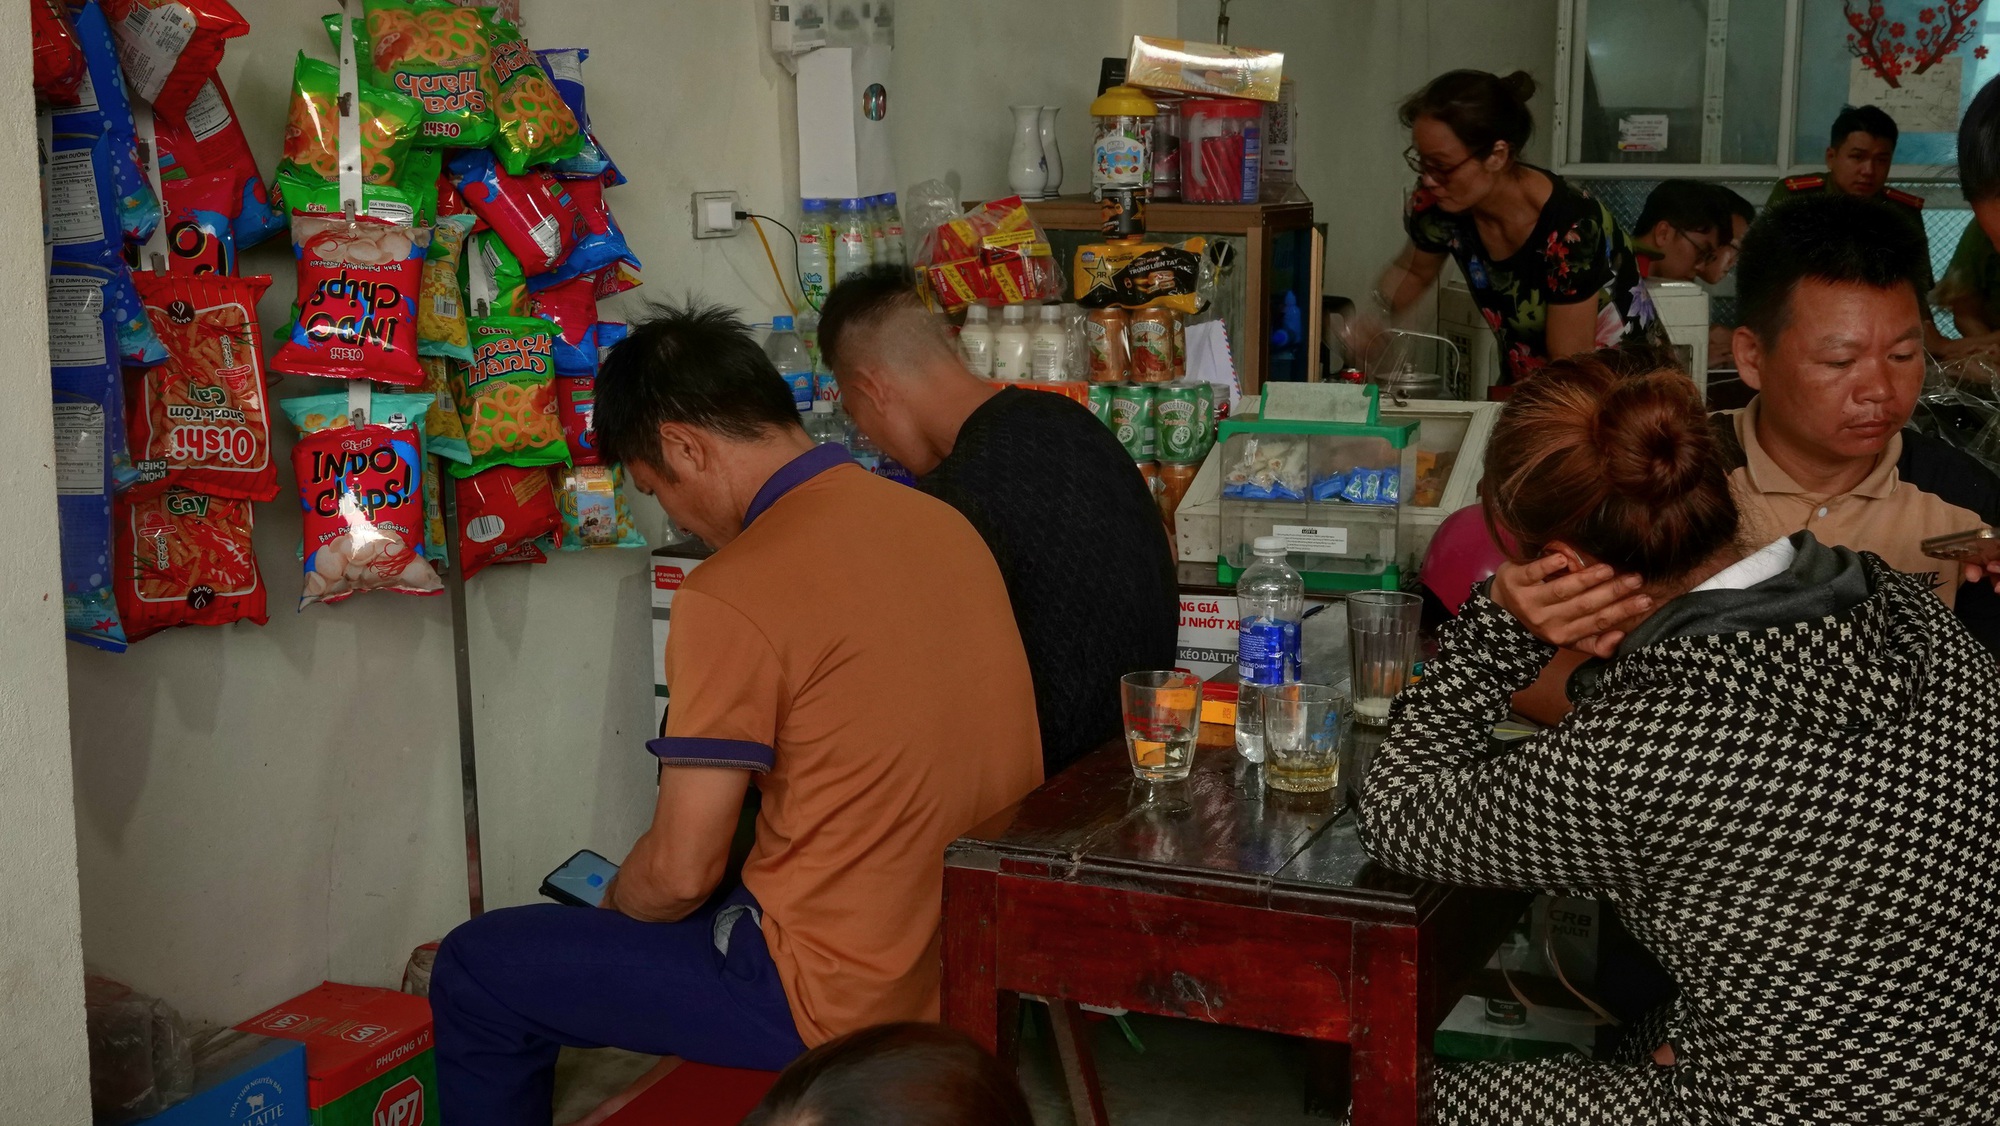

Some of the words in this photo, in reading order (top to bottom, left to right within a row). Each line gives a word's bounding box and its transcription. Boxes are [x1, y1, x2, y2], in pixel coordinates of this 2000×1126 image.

[423, 90, 487, 113] Sna
[423, 122, 460, 137] Oishi
[306, 312, 398, 352] INDO
[478, 326, 513, 335] Oishi
[330, 347, 363, 361] Oishi
[468, 348, 546, 386] Hành
[189, 383, 226, 405] Cay
[169, 406, 201, 420] Tôm
[202, 407, 244, 423] Snack
[170, 427, 255, 464] Oishi
[341, 438, 372, 451] Oishi
[312, 447, 398, 484] INDO
[166, 495, 209, 516] Cay
[192, 586, 213, 595] RANG
[1179, 601, 1195, 612] NG
[1197, 601, 1220, 613] GIÁ
[1189, 616, 1225, 629] NHỚT
[1180, 648, 1200, 660] KÉO
[1201, 650, 1219, 662] DÀI
